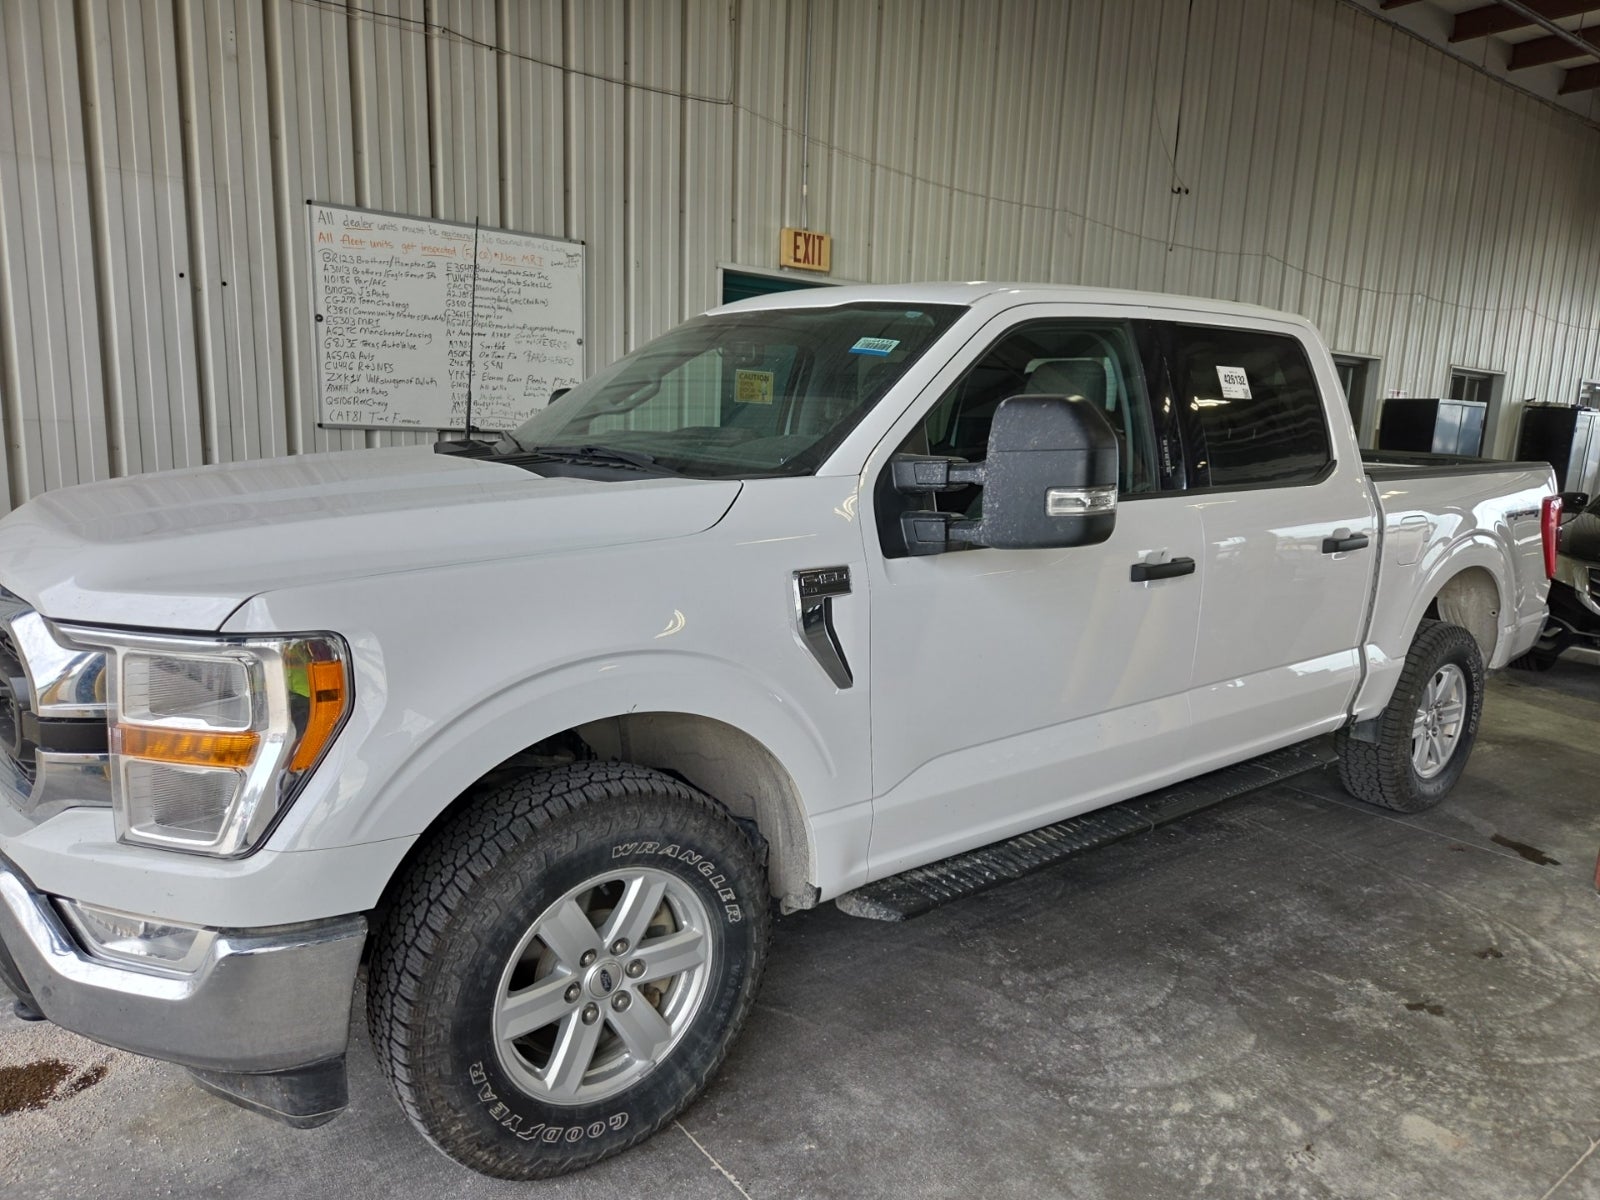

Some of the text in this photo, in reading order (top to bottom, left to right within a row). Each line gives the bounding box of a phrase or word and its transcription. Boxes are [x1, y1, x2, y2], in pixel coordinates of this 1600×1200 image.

[318, 209, 334, 225] All
[343, 214, 374, 228] dealer
[377, 222, 398, 232] units
[318, 231, 333, 244] All
[370, 239, 394, 249] units
[401, 242, 416, 254] get
[793, 231, 824, 266] EXIT
[738, 372, 770, 382] CAUTION
[611, 841, 742, 924] WRANGLER
[469, 1061, 630, 1144] GOODYEAR
